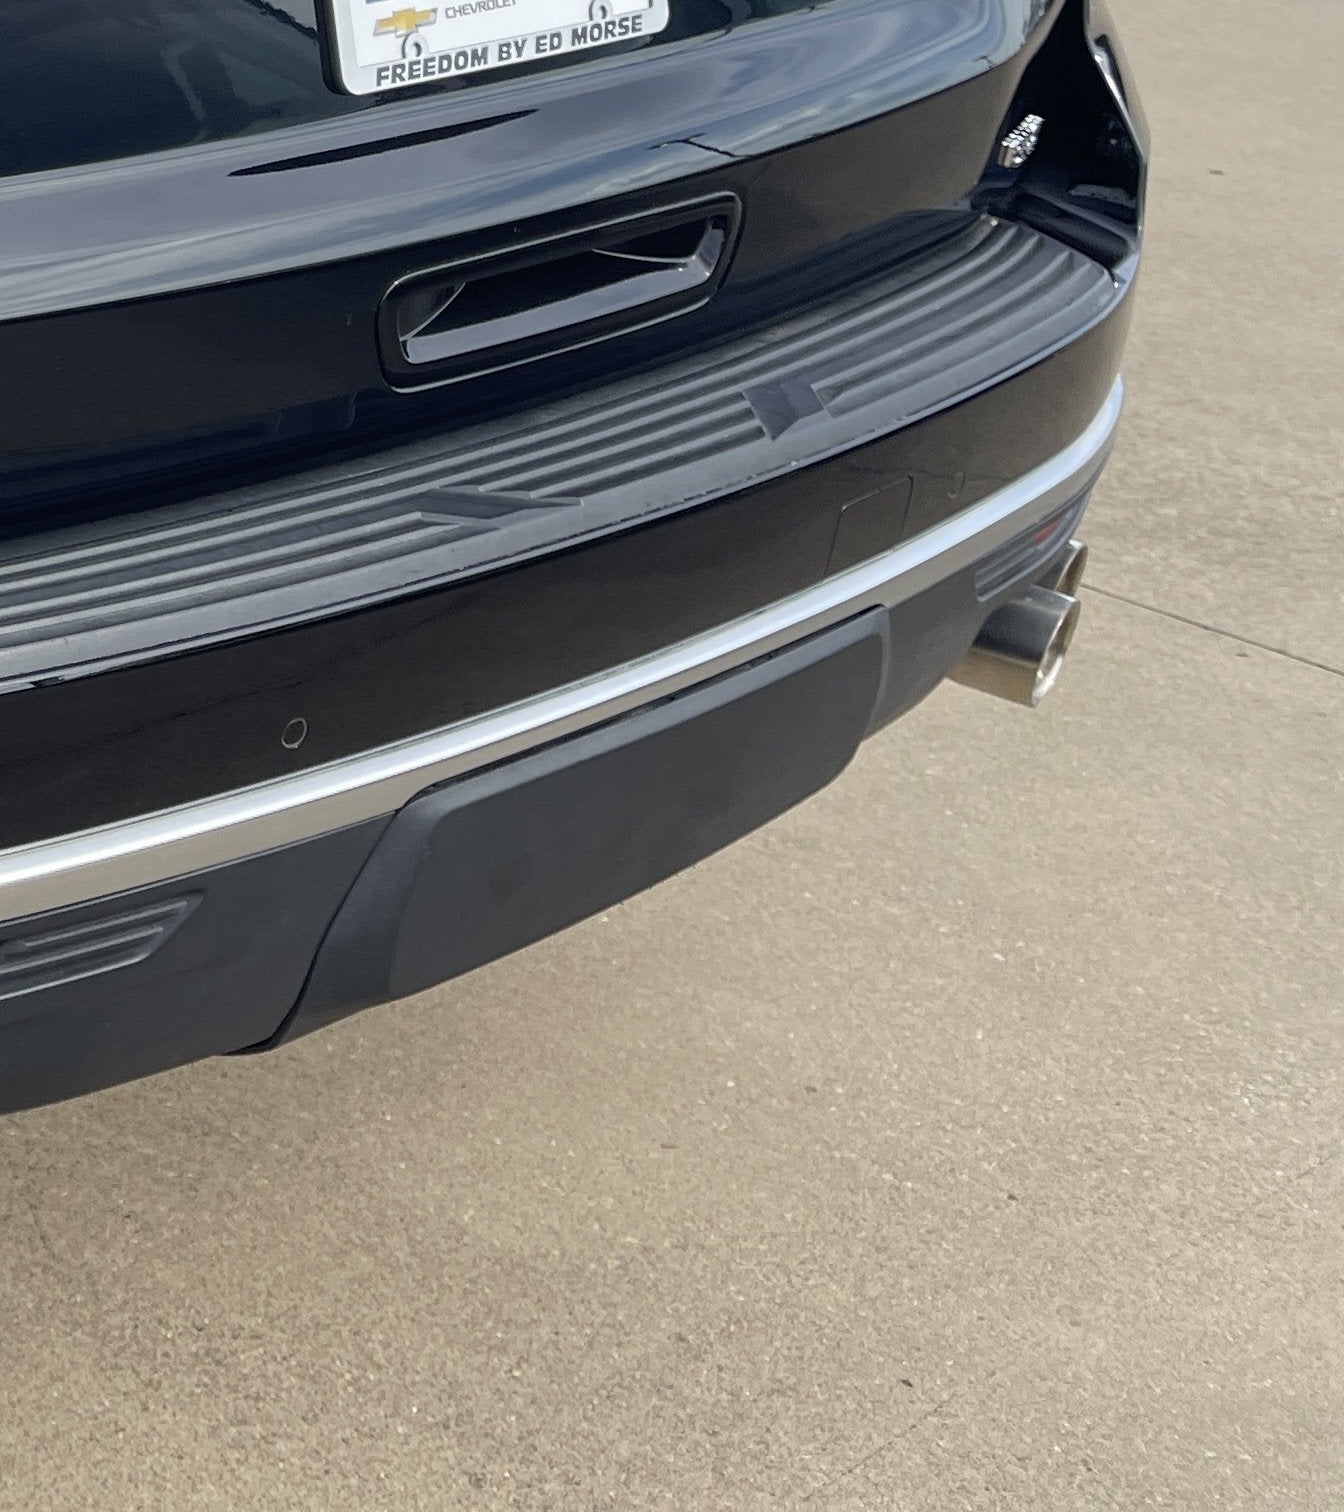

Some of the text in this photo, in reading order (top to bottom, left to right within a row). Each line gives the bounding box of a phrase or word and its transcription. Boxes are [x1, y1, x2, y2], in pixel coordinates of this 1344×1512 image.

[376, 14, 644, 87] FREEDOM BY ED MORSE
